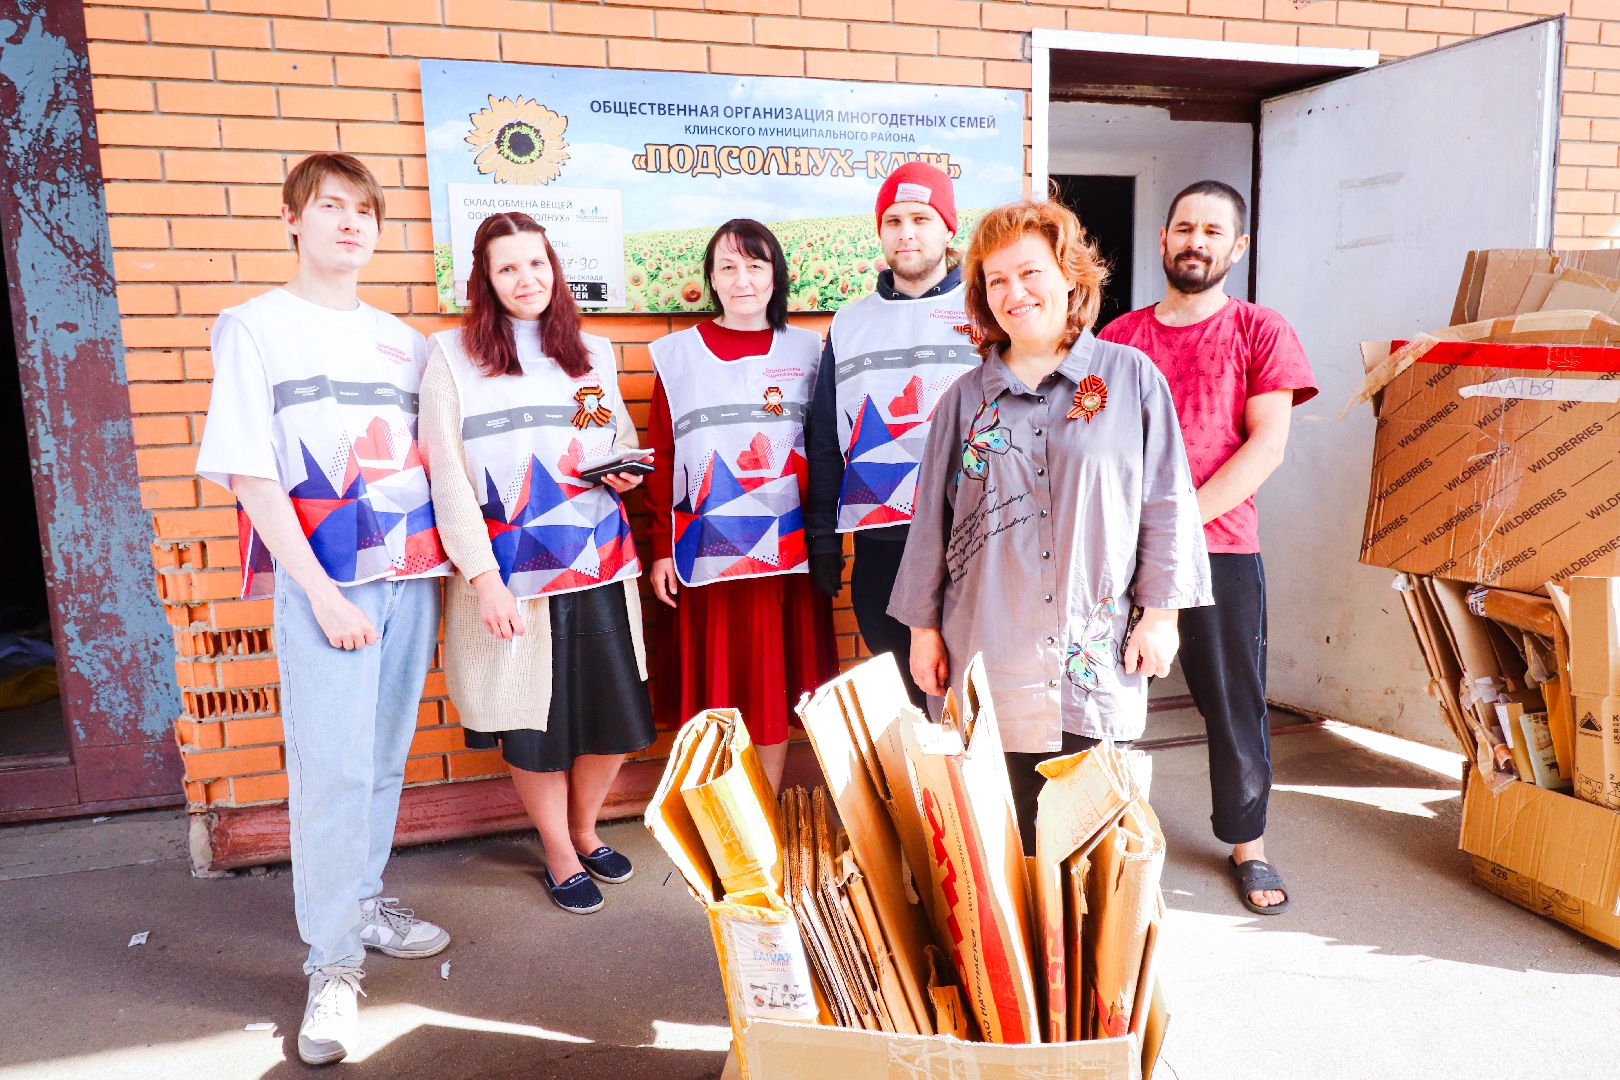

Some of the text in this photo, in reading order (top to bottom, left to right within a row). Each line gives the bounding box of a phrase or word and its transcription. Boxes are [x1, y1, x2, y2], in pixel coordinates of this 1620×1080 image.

[590, 100, 996, 129] ОБЩЕСТВЕННАЯ ОРГАНИЗАЦИЯ МНОГОДЕТНЫХ СЕМЕЙ
[685, 125, 915, 143] КЛИНСКОГО МУНИЦИПАЛЬНОГО РАЙОНА
[463, 198, 573, 210] СКЛАД ОБМЕНА ВЕЩЕЙ
[1397, 401, 1459, 449] WILDBERRIES
[1527, 422, 1604, 474] WILDBERRIES
[1420, 501, 1482, 546] WILDBERRIES
[1495, 488, 1567, 536] WILDBERRIES
[1491, 866, 1508, 880] 426
